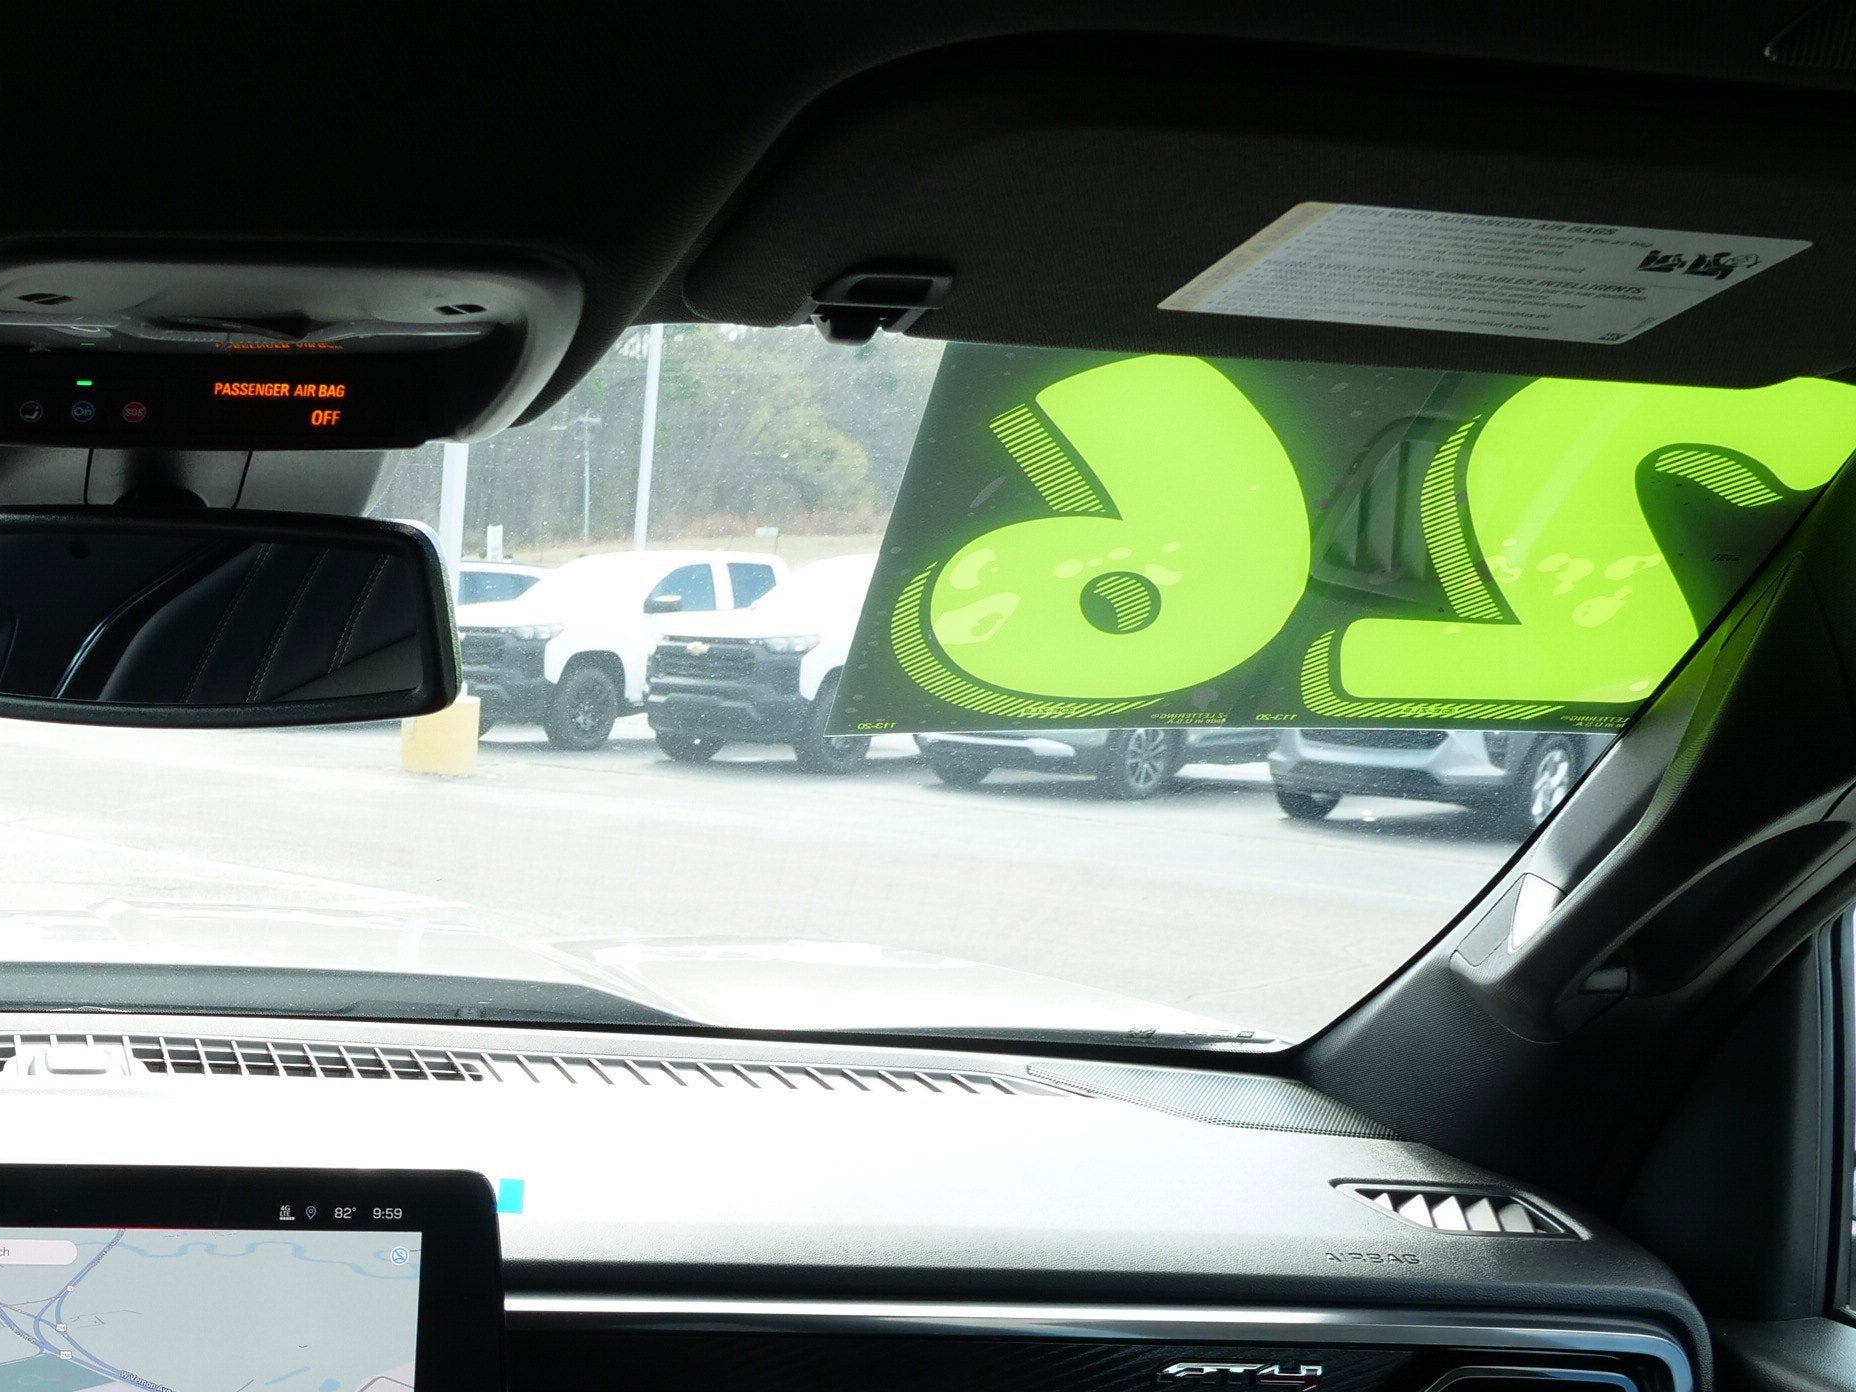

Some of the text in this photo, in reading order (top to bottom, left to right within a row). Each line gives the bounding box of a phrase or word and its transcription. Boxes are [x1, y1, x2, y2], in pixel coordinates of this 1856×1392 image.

[214, 382, 345, 398] PASSENGER AIR BAG
[125, 407, 144, 416] SOS
[311, 410, 341, 425] OFF
[334, 1207, 357, 1219] 82°
[373, 1207, 403, 1219] 9:59
[128, 1374, 156, 1391] Vernon
